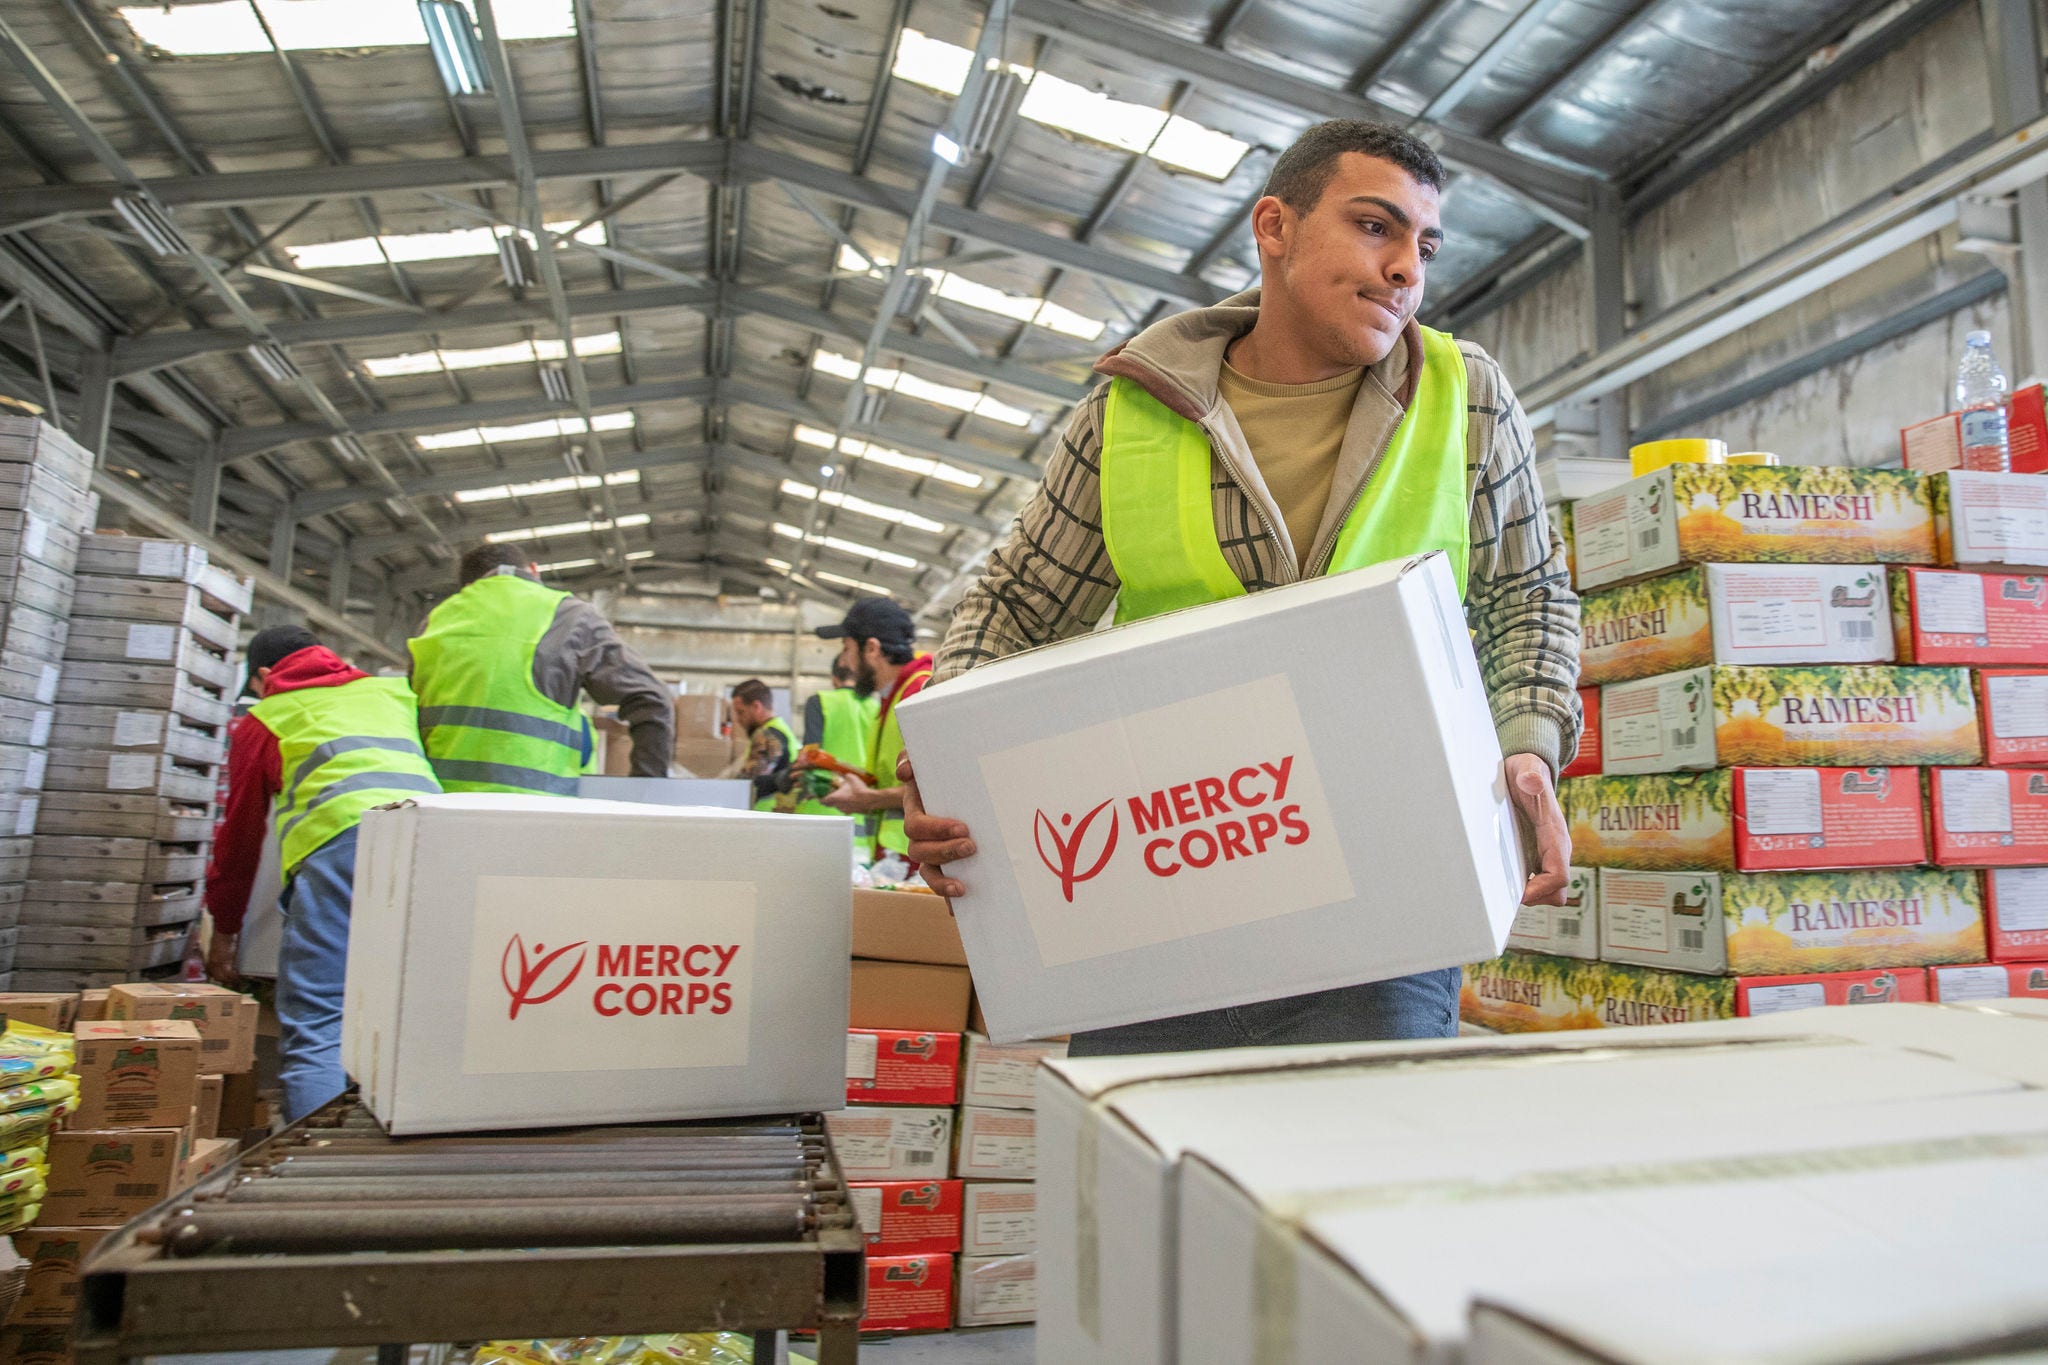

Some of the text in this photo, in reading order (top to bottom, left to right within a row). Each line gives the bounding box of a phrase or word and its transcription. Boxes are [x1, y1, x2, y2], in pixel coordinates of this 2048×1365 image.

[1741, 493, 1873, 521] RAMESH
[1585, 608, 1667, 649] RAMESH
[1782, 697, 1917, 724] RAMESH
[1127, 755, 1293, 835] MERCY
[1600, 804, 1681, 831] RAMESH
[1144, 804, 1310, 877] CORPS
[1790, 899, 1922, 931] RAMESH
[596, 944, 741, 977] MERCY
[593, 982, 732, 1017] CORPS
[1480, 975, 1542, 1007] RAMESH
